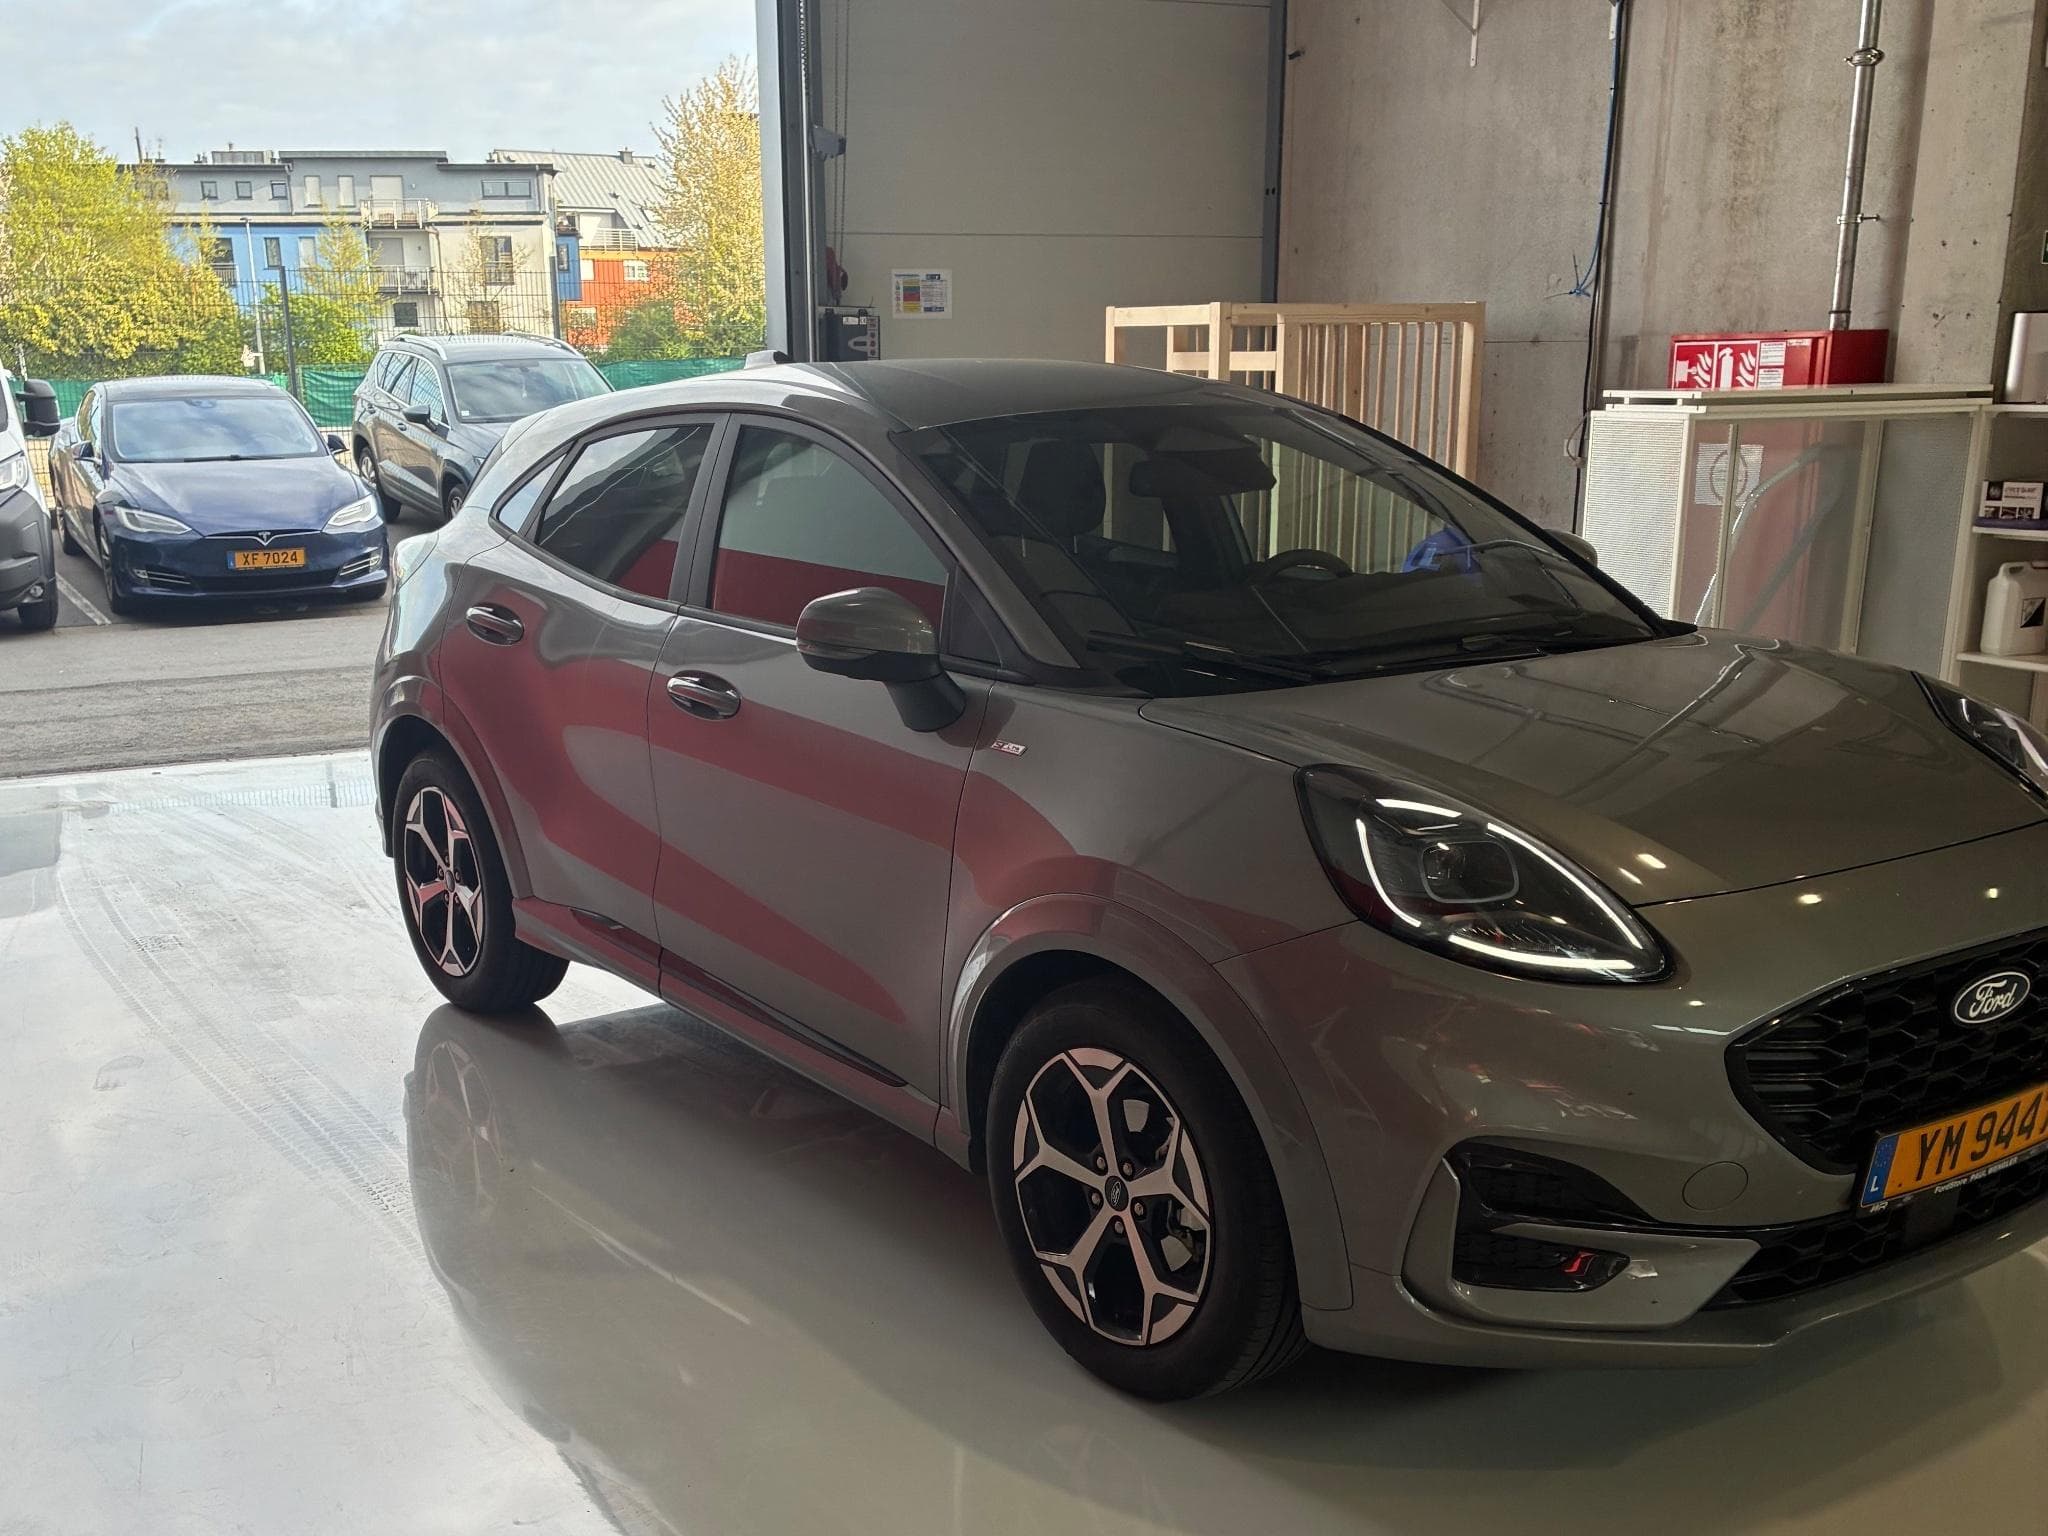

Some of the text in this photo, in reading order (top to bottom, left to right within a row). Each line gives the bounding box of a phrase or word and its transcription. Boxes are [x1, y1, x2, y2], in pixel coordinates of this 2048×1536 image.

[243, 551, 298, 565] XF 7024
[1968, 979, 2018, 1018] Ford
[1916, 1120, 1967, 1182] YM
[1870, 1175, 1879, 1193] L
